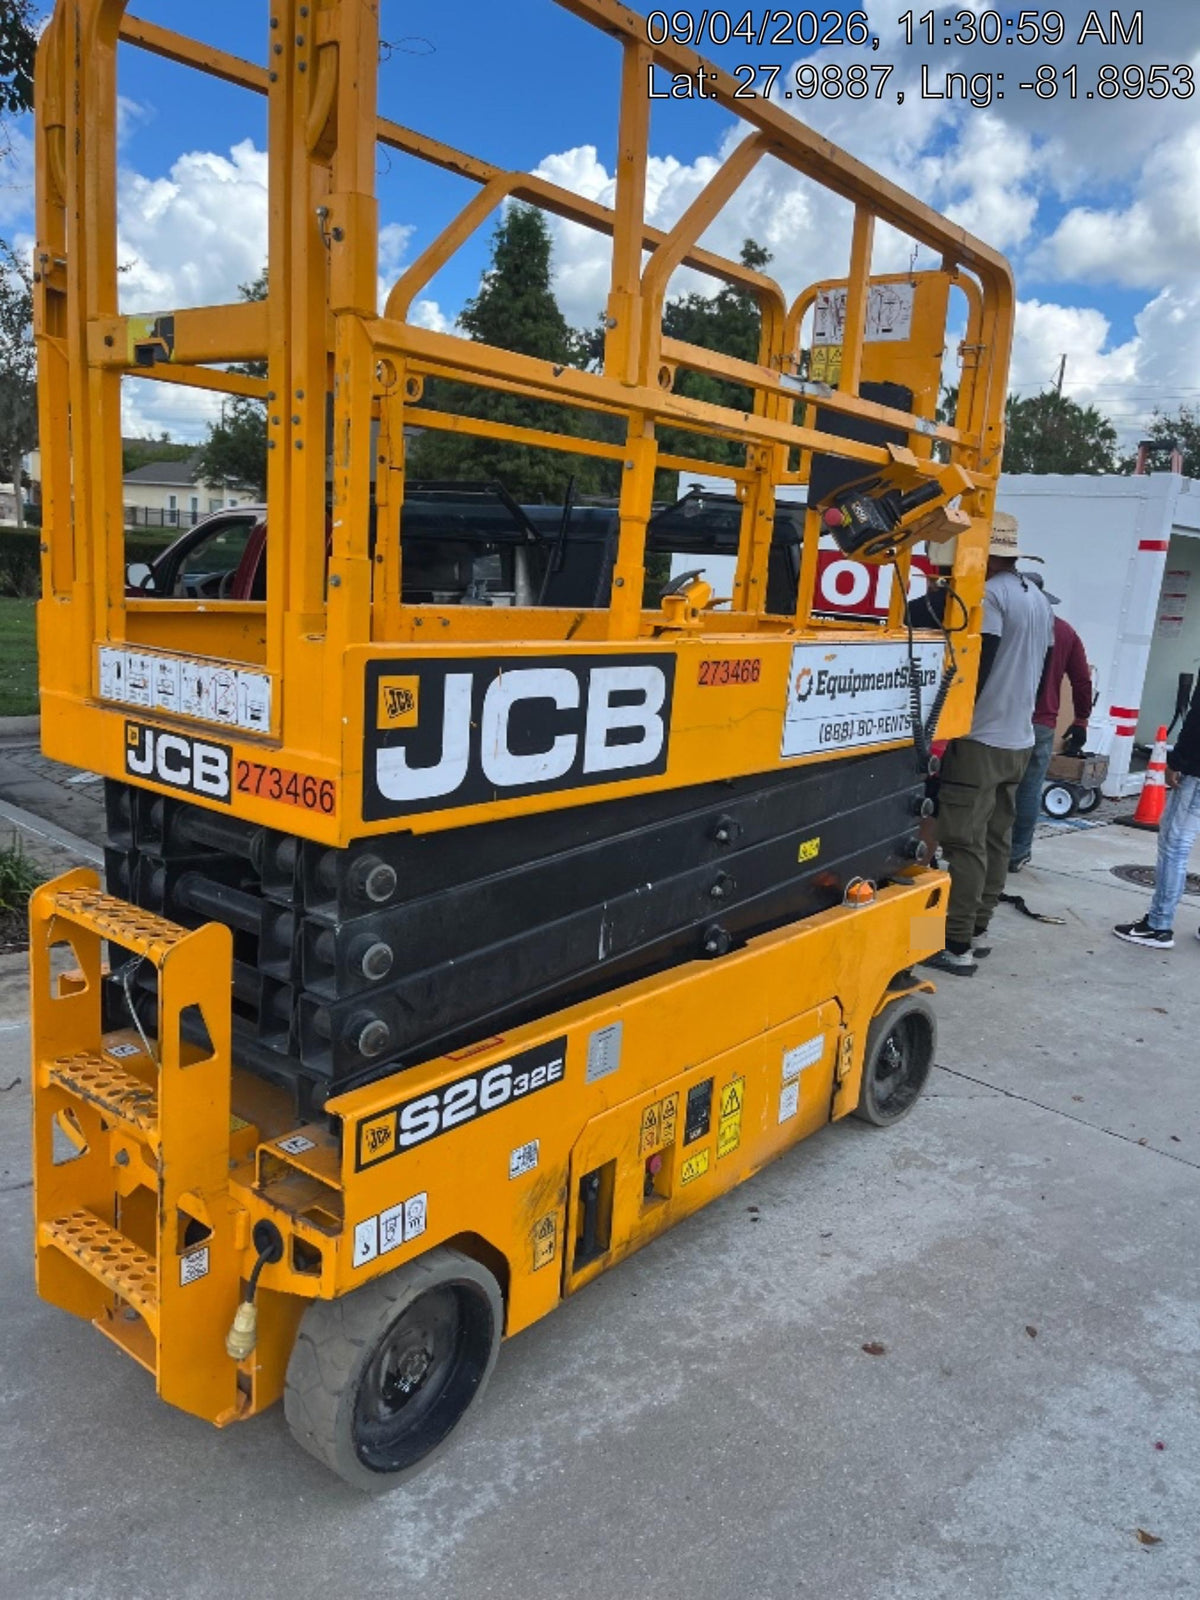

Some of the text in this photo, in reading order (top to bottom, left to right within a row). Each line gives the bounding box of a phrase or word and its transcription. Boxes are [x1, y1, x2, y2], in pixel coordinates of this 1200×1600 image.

[698, 659, 761, 685] 273466
[815, 667, 936, 700] EquipmentSare
[376, 665, 667, 801] JCB
[127, 729, 231, 797] JCB
[237, 761, 334, 814] 273466
